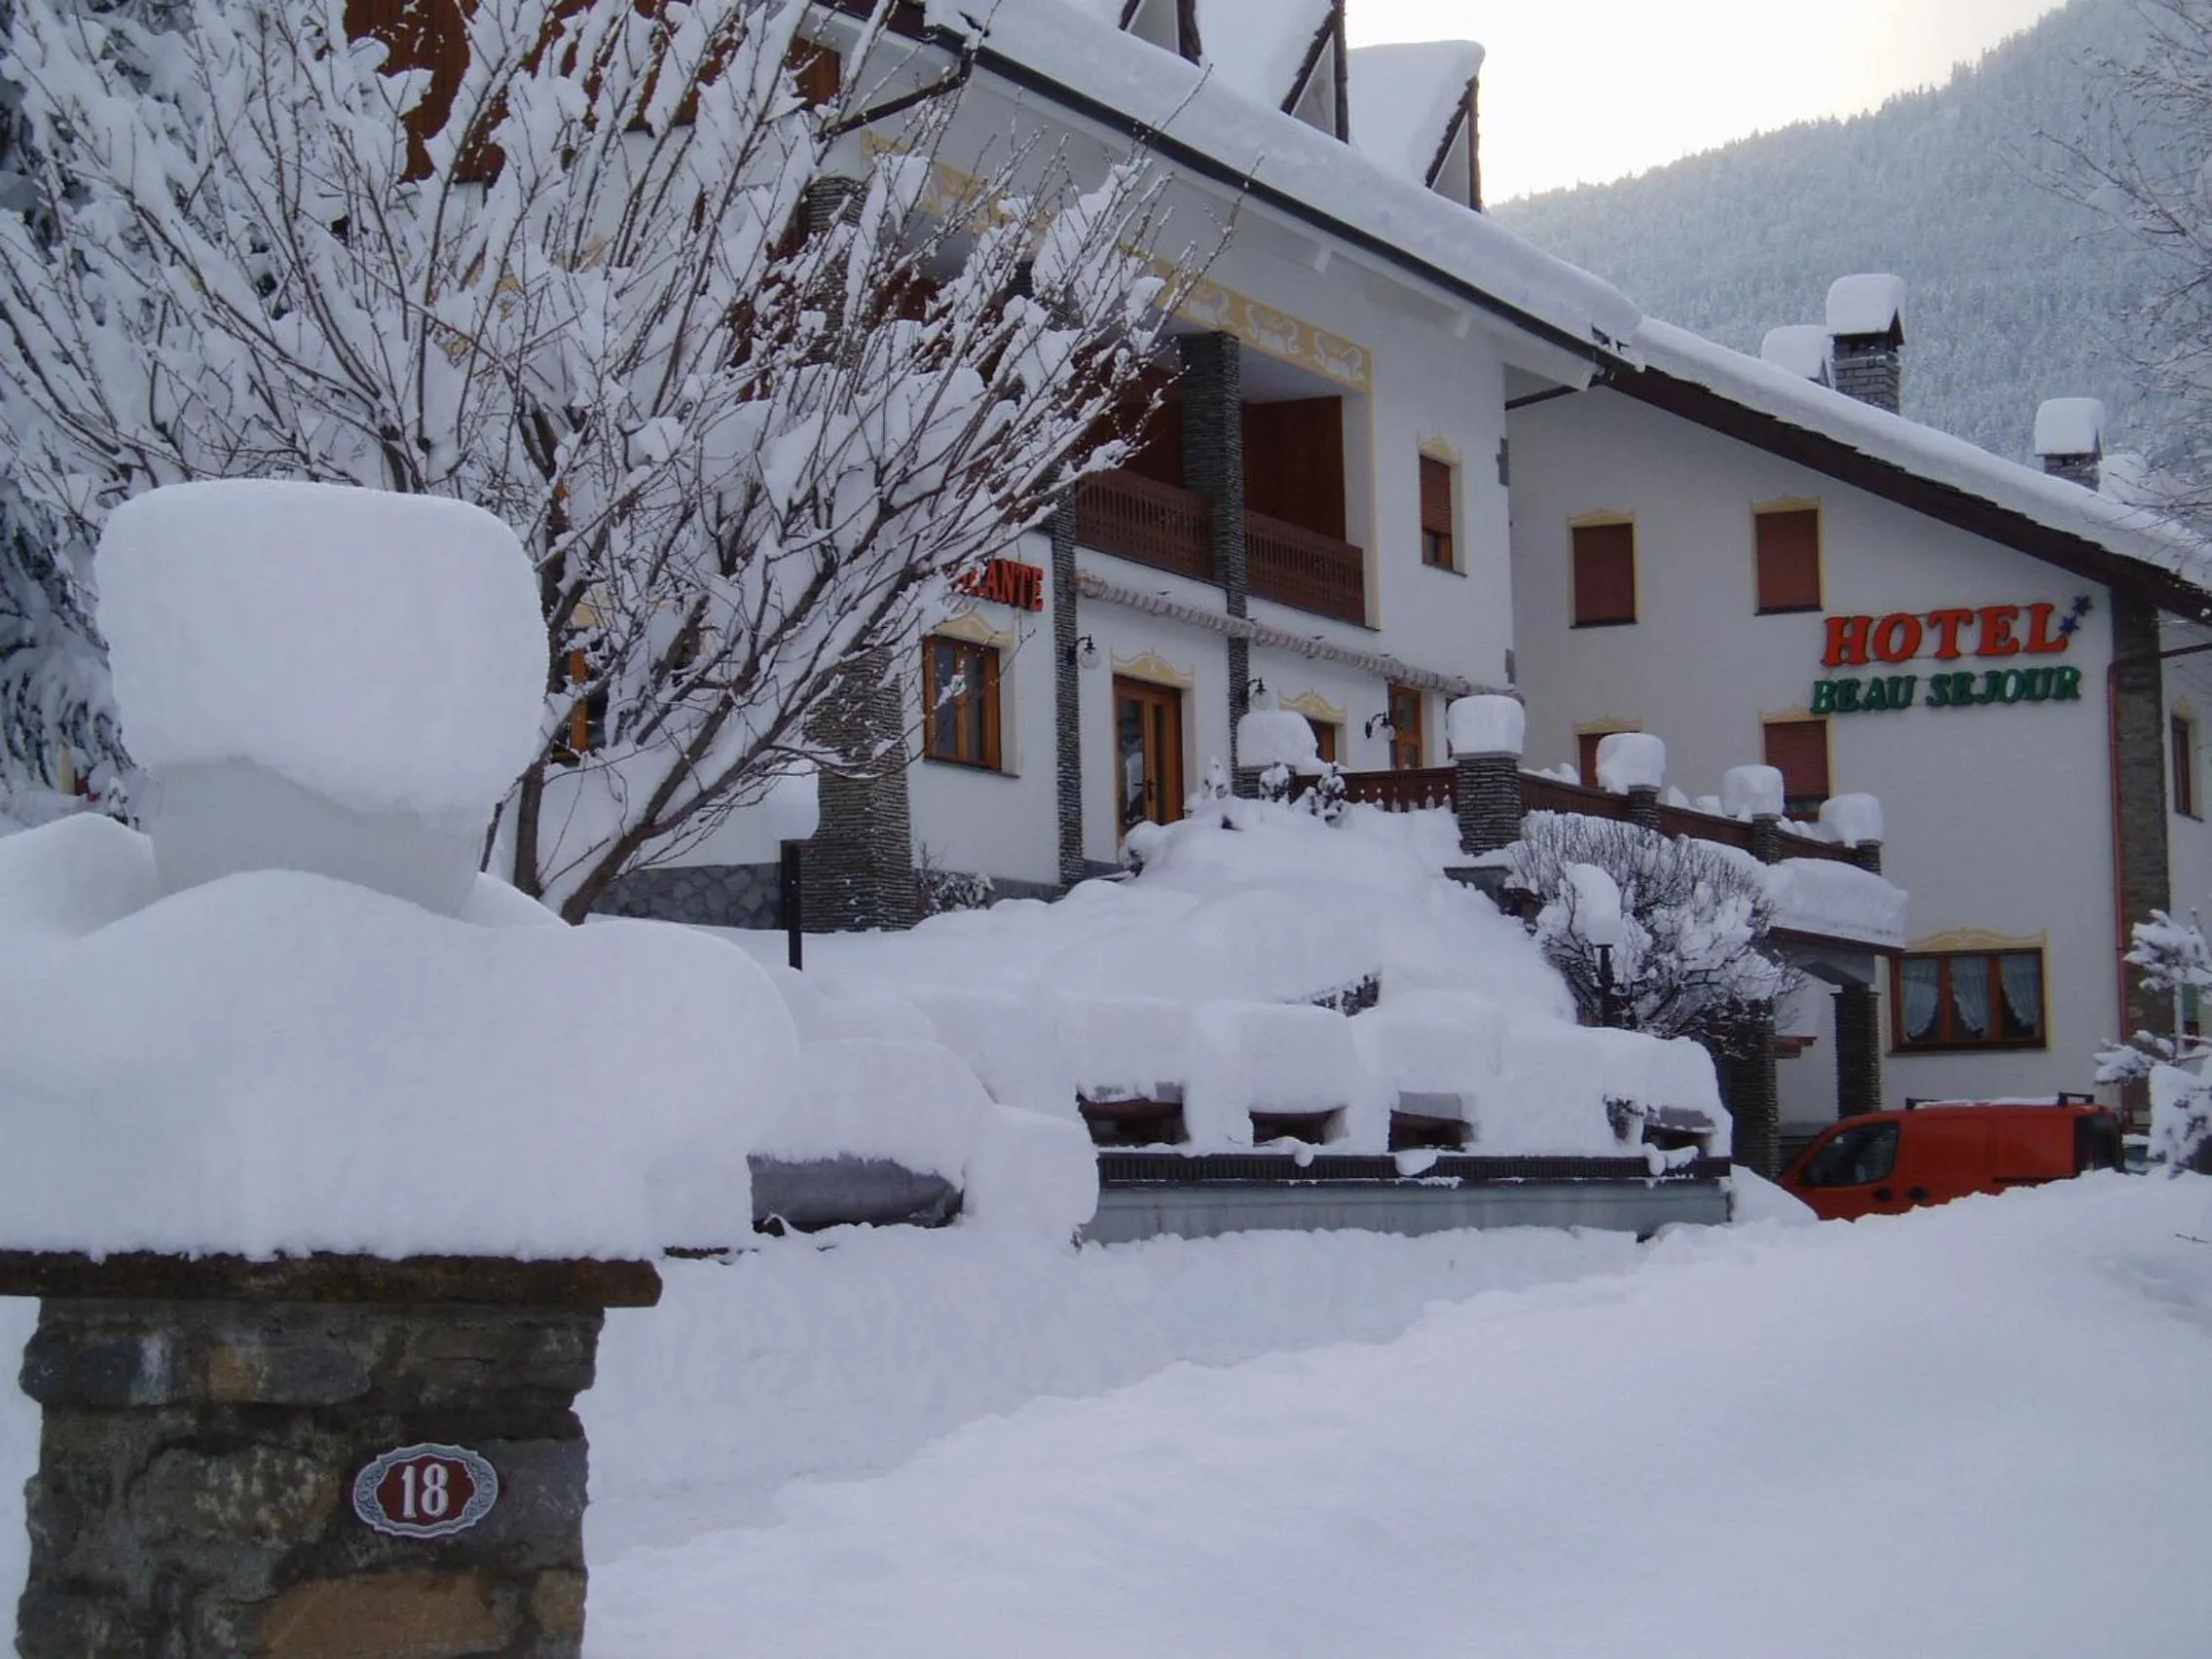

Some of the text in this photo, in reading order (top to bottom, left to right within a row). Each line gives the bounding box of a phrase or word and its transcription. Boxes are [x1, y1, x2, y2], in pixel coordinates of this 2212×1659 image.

[941, 558, 1045, 612] ANTE
[1821, 602, 2070, 667] HOTEL
[1809, 665, 2083, 715] BEAU SEJOUR
[401, 1462, 450, 1519] 18
